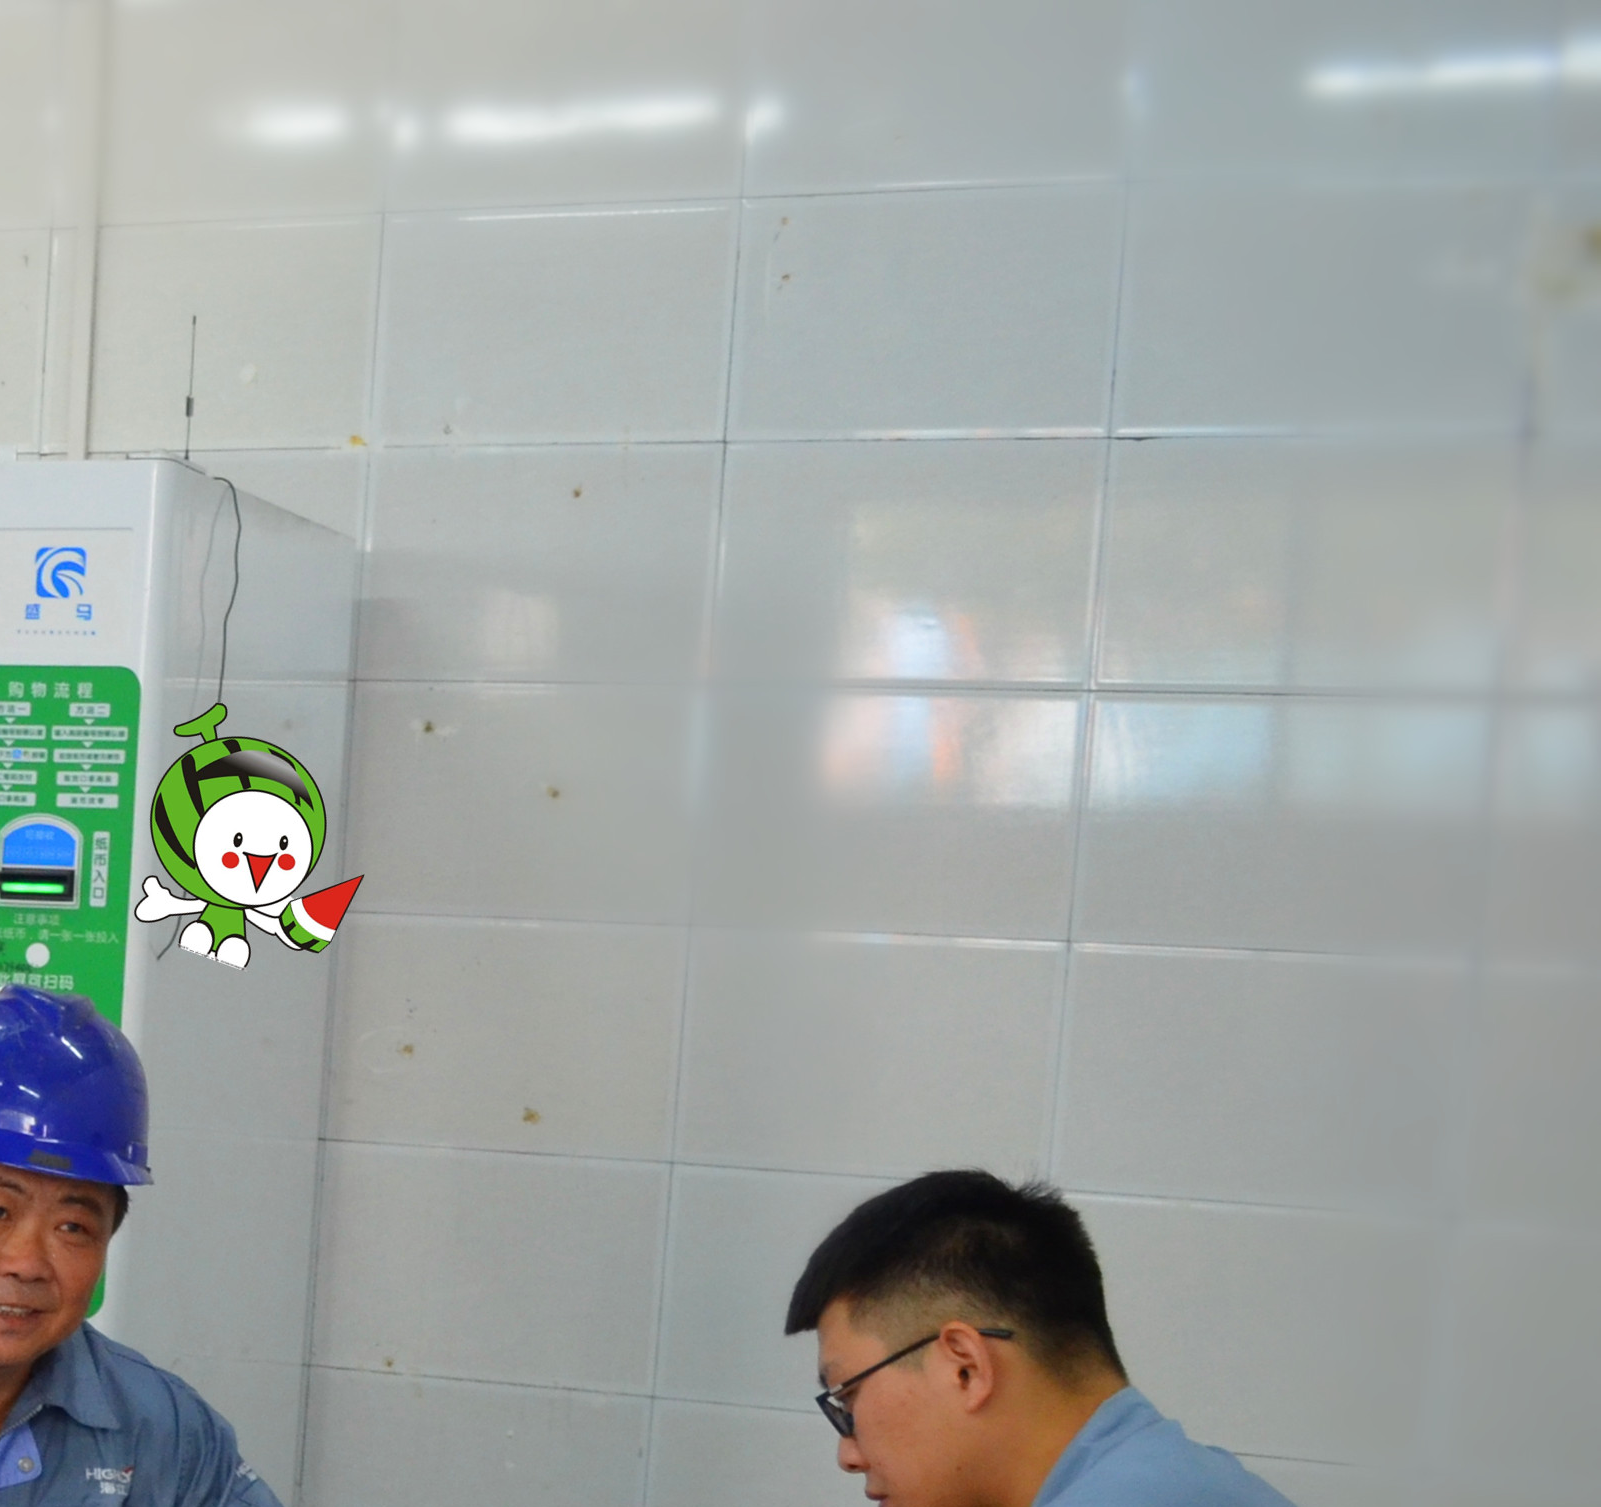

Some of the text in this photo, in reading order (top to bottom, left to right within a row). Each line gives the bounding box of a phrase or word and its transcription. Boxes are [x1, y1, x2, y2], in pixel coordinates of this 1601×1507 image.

[8, 681, 93, 699] 购物流程
[93, 837, 108, 899] 纸币入口
[14, 913, 60, 926] 注意事项
